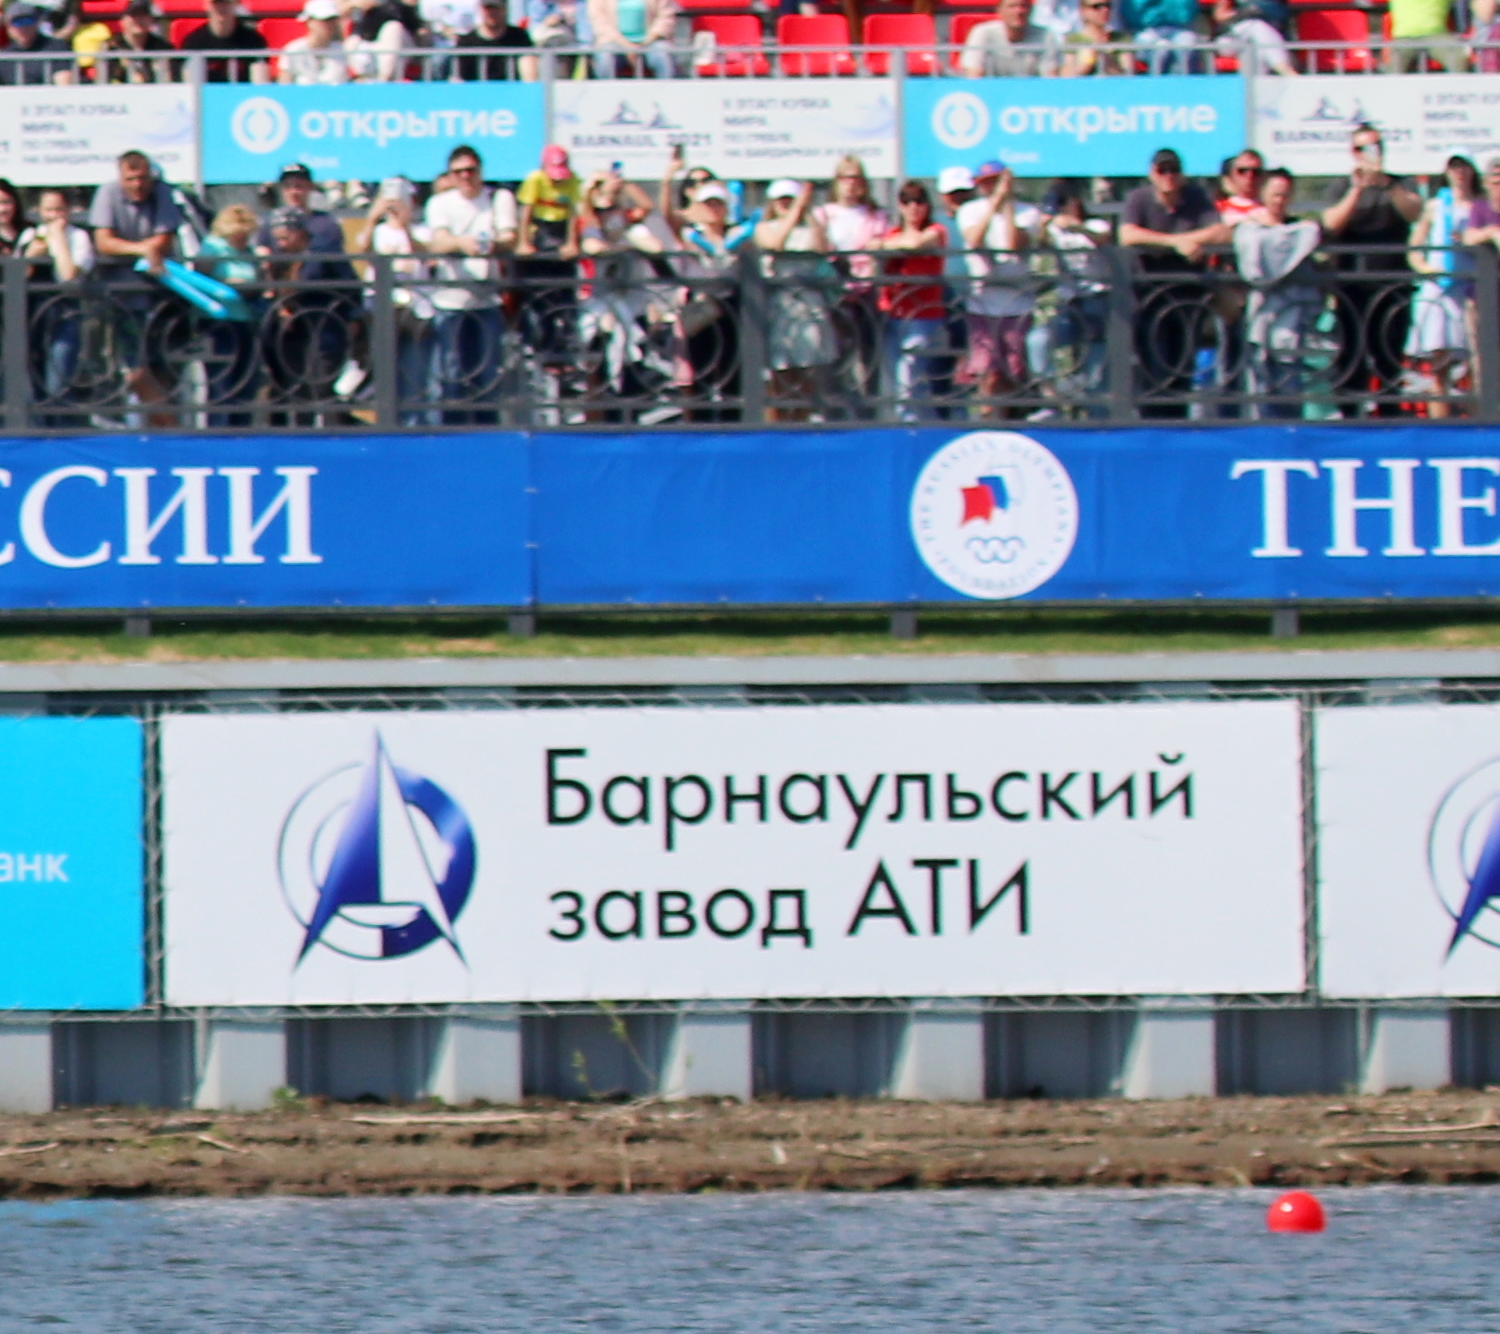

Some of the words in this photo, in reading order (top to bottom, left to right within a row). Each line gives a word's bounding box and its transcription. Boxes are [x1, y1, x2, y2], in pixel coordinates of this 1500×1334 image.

[299, 108, 518, 147] открытие
[572, 135, 658, 147] BARNAUL
[666, 133, 713, 146] 2021
[1000, 104, 1218, 143] открытие
[1230, 457, 1500, 557] THE
[545, 749, 1195, 847] Барнаульский
[548, 884, 812, 948] завод
[846, 859, 1030, 939] АТИ
